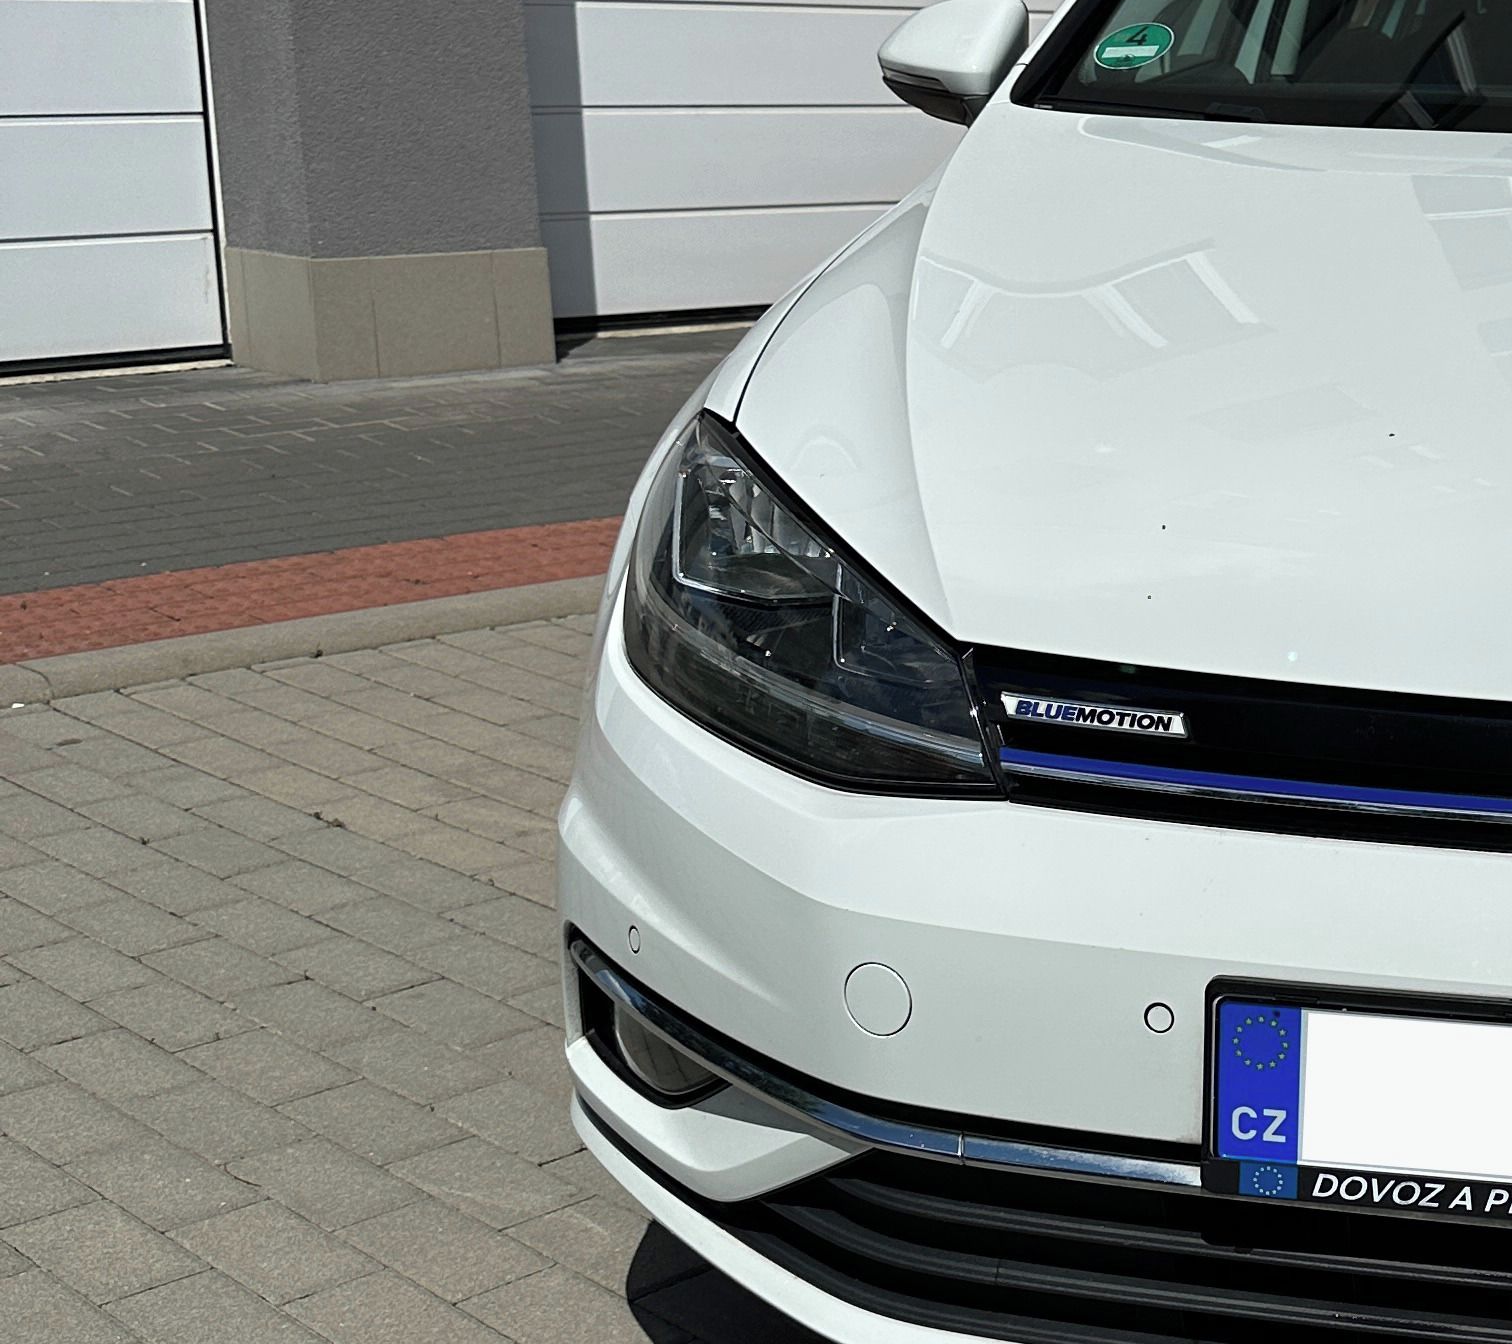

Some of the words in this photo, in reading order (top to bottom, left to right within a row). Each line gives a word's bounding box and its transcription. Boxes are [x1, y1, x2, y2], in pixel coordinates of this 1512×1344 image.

[1126, 26, 1149, 46] 4
[1015, 699, 1173, 732] BLUEMOTION
[1231, 1106, 1287, 1143] CZ
[1311, 1173, 1446, 1208] DOVOZ
[1448, 1186, 1473, 1211] A
